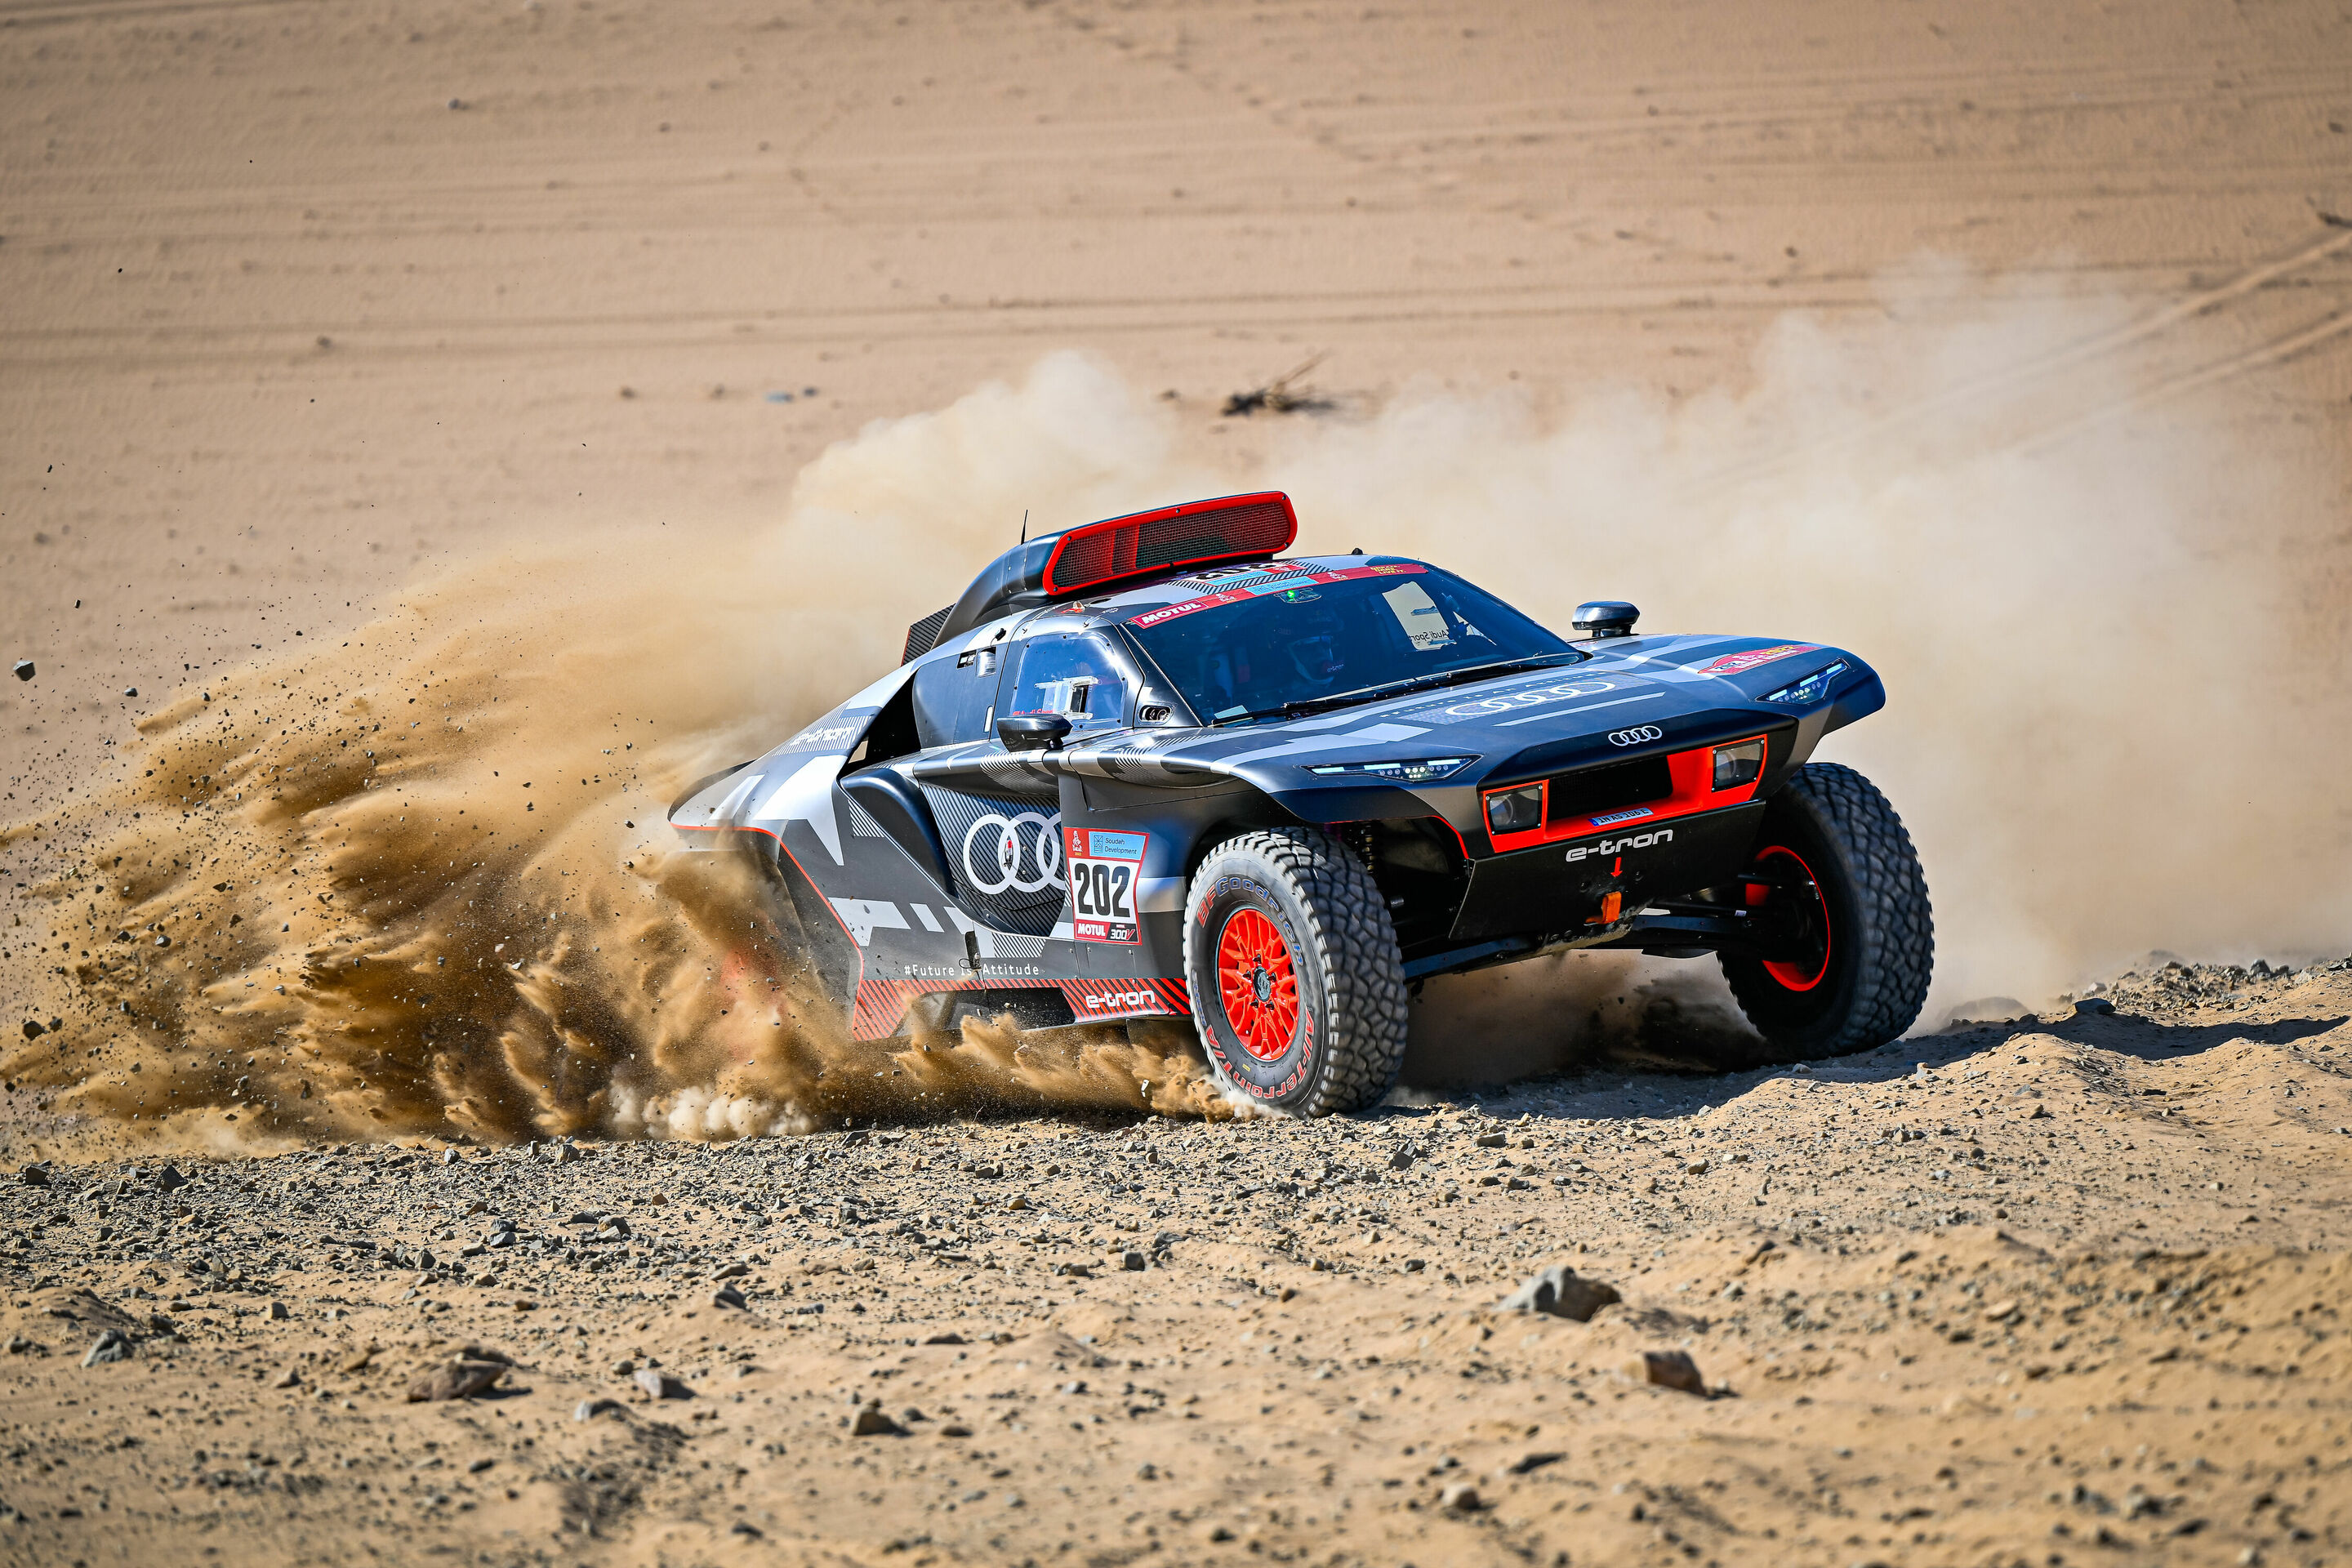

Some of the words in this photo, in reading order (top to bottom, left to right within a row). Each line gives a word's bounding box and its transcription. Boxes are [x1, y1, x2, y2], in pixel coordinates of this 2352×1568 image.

[1141, 600, 1203, 625] MOTUL
[1105, 837, 1125, 845] Soudah
[1566, 829, 1673, 862] e-tron
[1104, 845, 1138, 855] Development
[1074, 862, 1131, 918] 202
[1197, 876, 1303, 966] BFGoodrich
[1077, 923, 1106, 937] MOTUL
[1110, 929, 1136, 941] 300V
[904, 964, 955, 977] #Future
[982, 963, 1040, 975] Attitude
[1085, 990, 1156, 1009] e-tron
